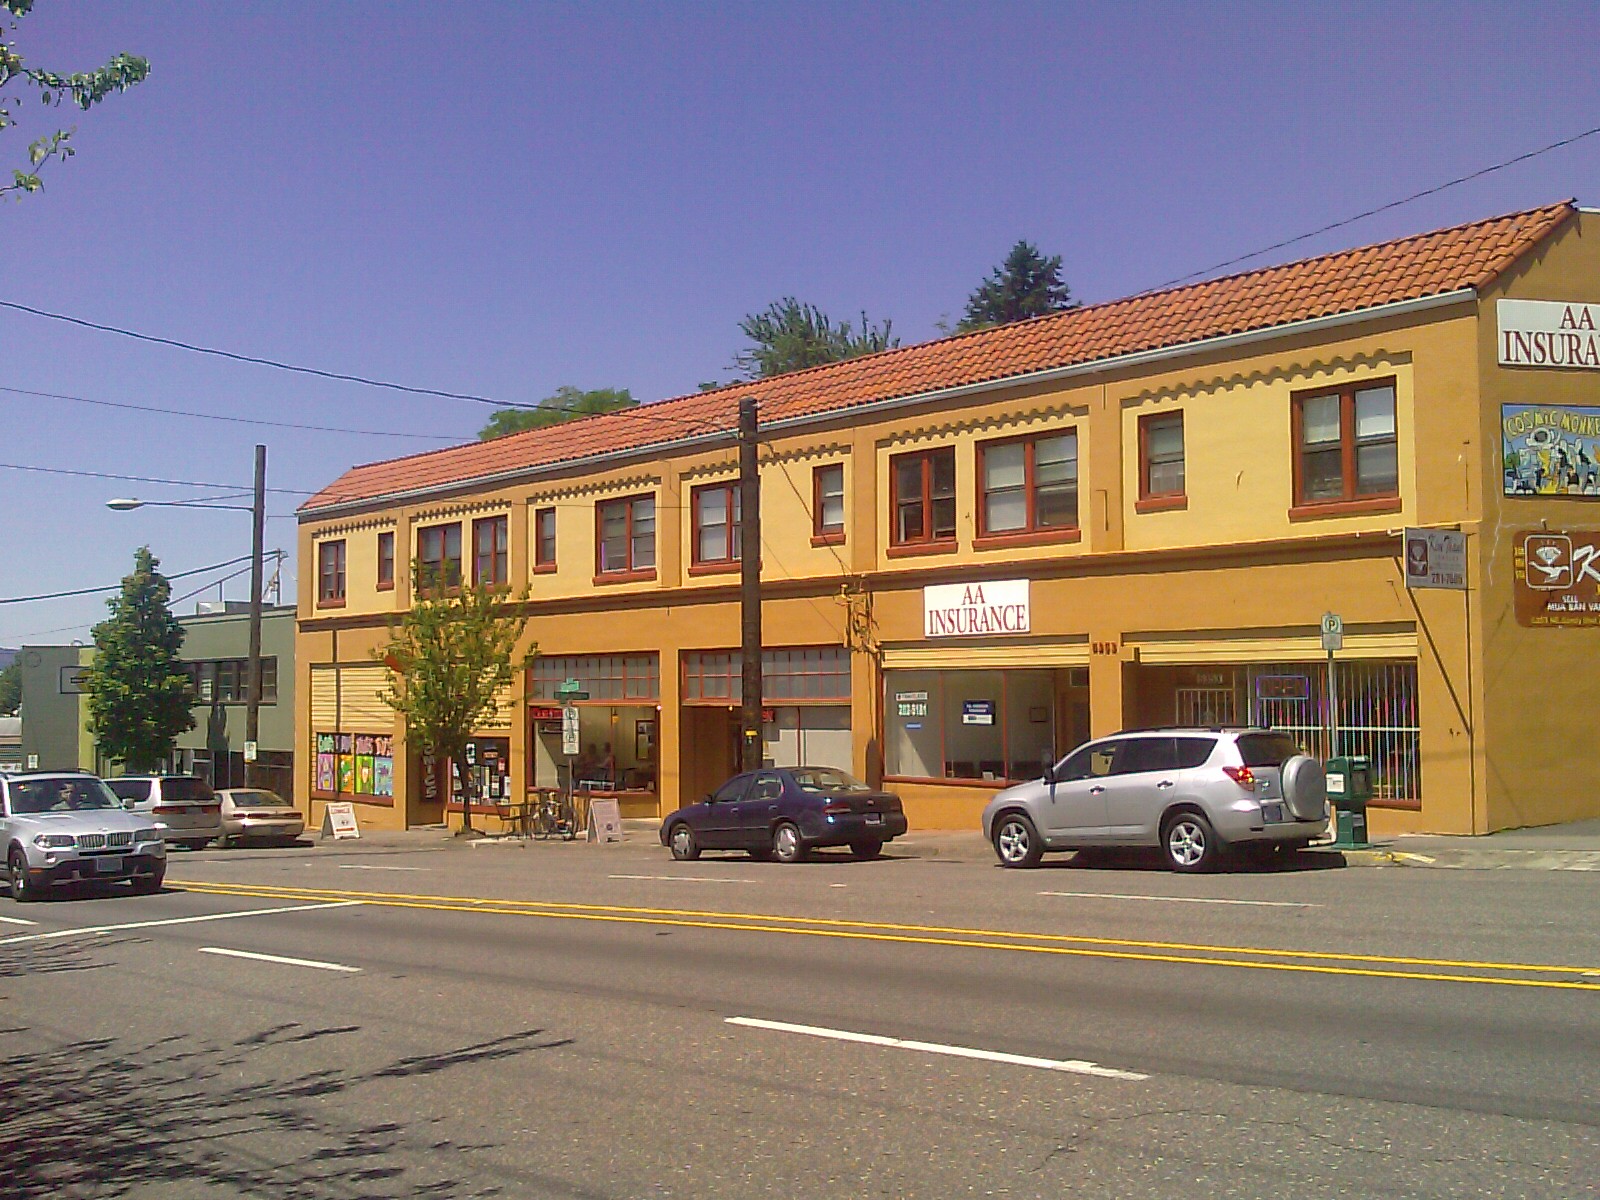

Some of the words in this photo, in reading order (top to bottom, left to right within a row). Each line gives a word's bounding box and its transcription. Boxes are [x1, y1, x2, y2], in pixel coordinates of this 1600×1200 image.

[1559, 304, 1597, 330] AA
[1502, 330, 1600, 365] INSURA
[1507, 410, 1557, 436] COSMIC
[962, 584, 985, 605] AA
[929, 604, 1027, 635] INSURANCE
[1260, 677, 1304, 697] OPEN
